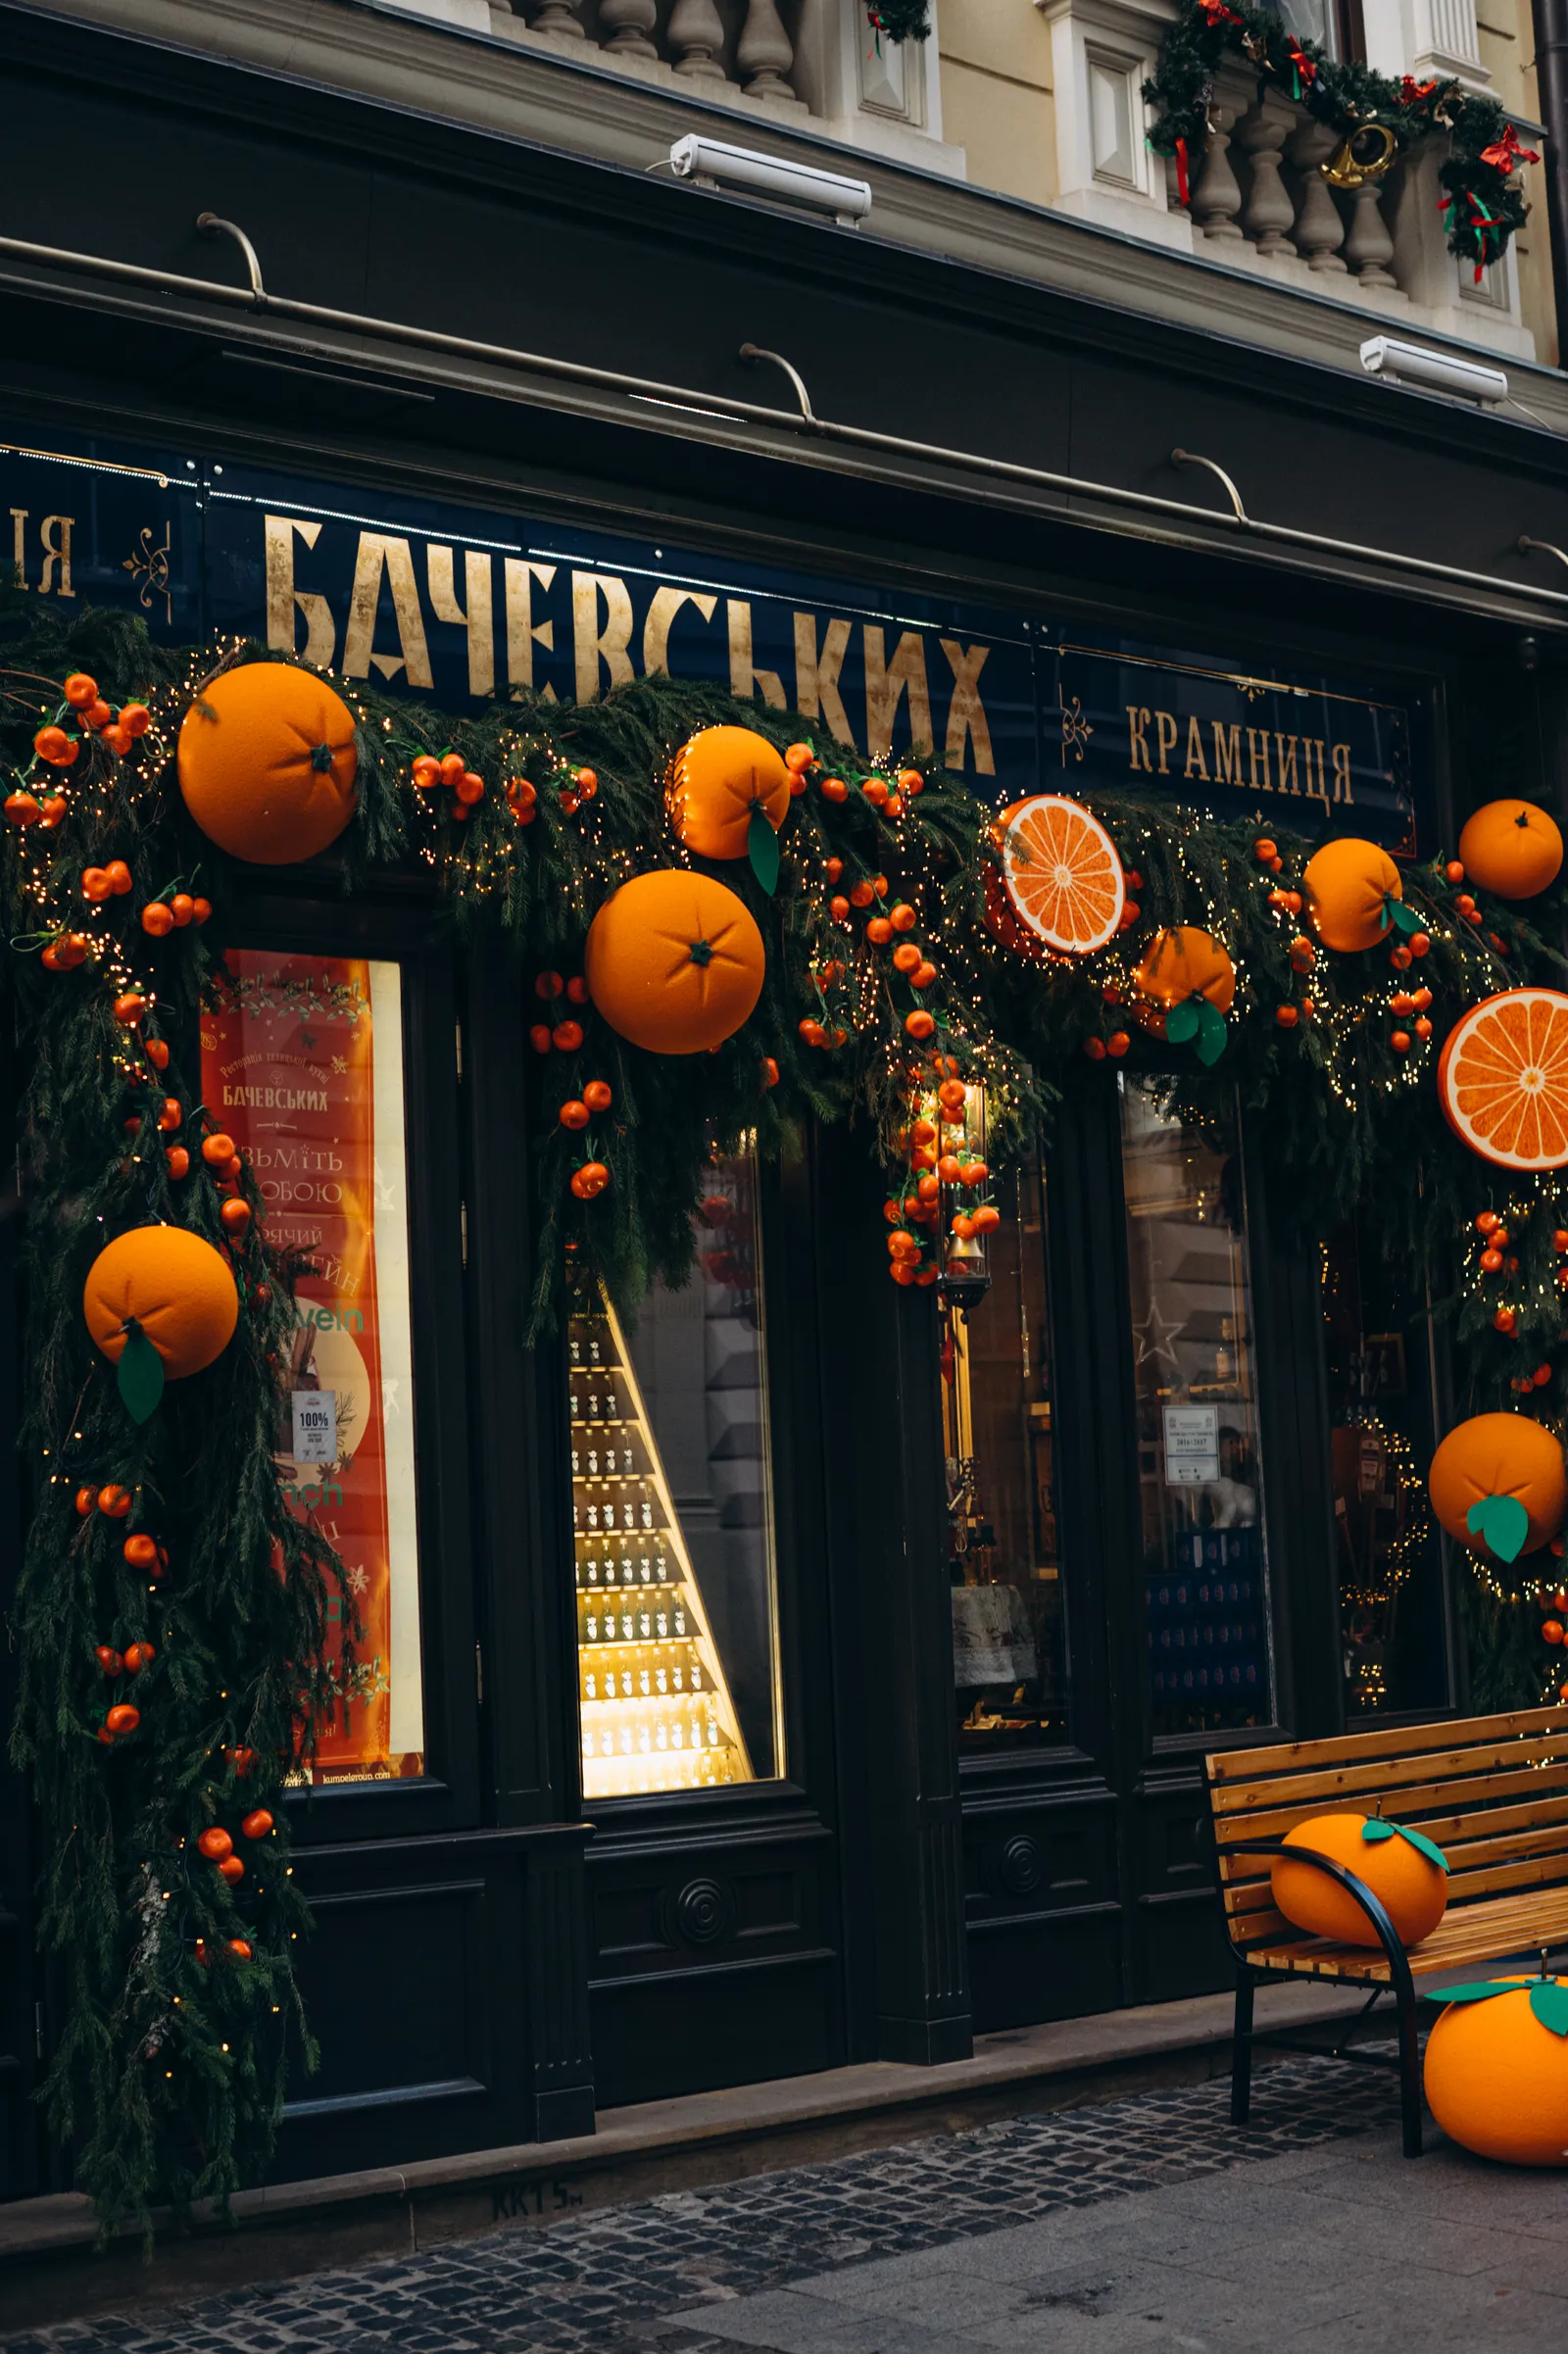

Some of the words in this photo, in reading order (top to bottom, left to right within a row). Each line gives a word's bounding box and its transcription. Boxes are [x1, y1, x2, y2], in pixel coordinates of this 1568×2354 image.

[265, 515, 996, 775] БАЧЕВСЬКИХ
[1126, 705, 1354, 817] КРАМНИЦЯ
[223, 1085, 328, 1112] БАЧЕВСЬКИХ
[260, 1181, 343, 1203] ОБОЮ
[300, 1412, 329, 1427] 100%
